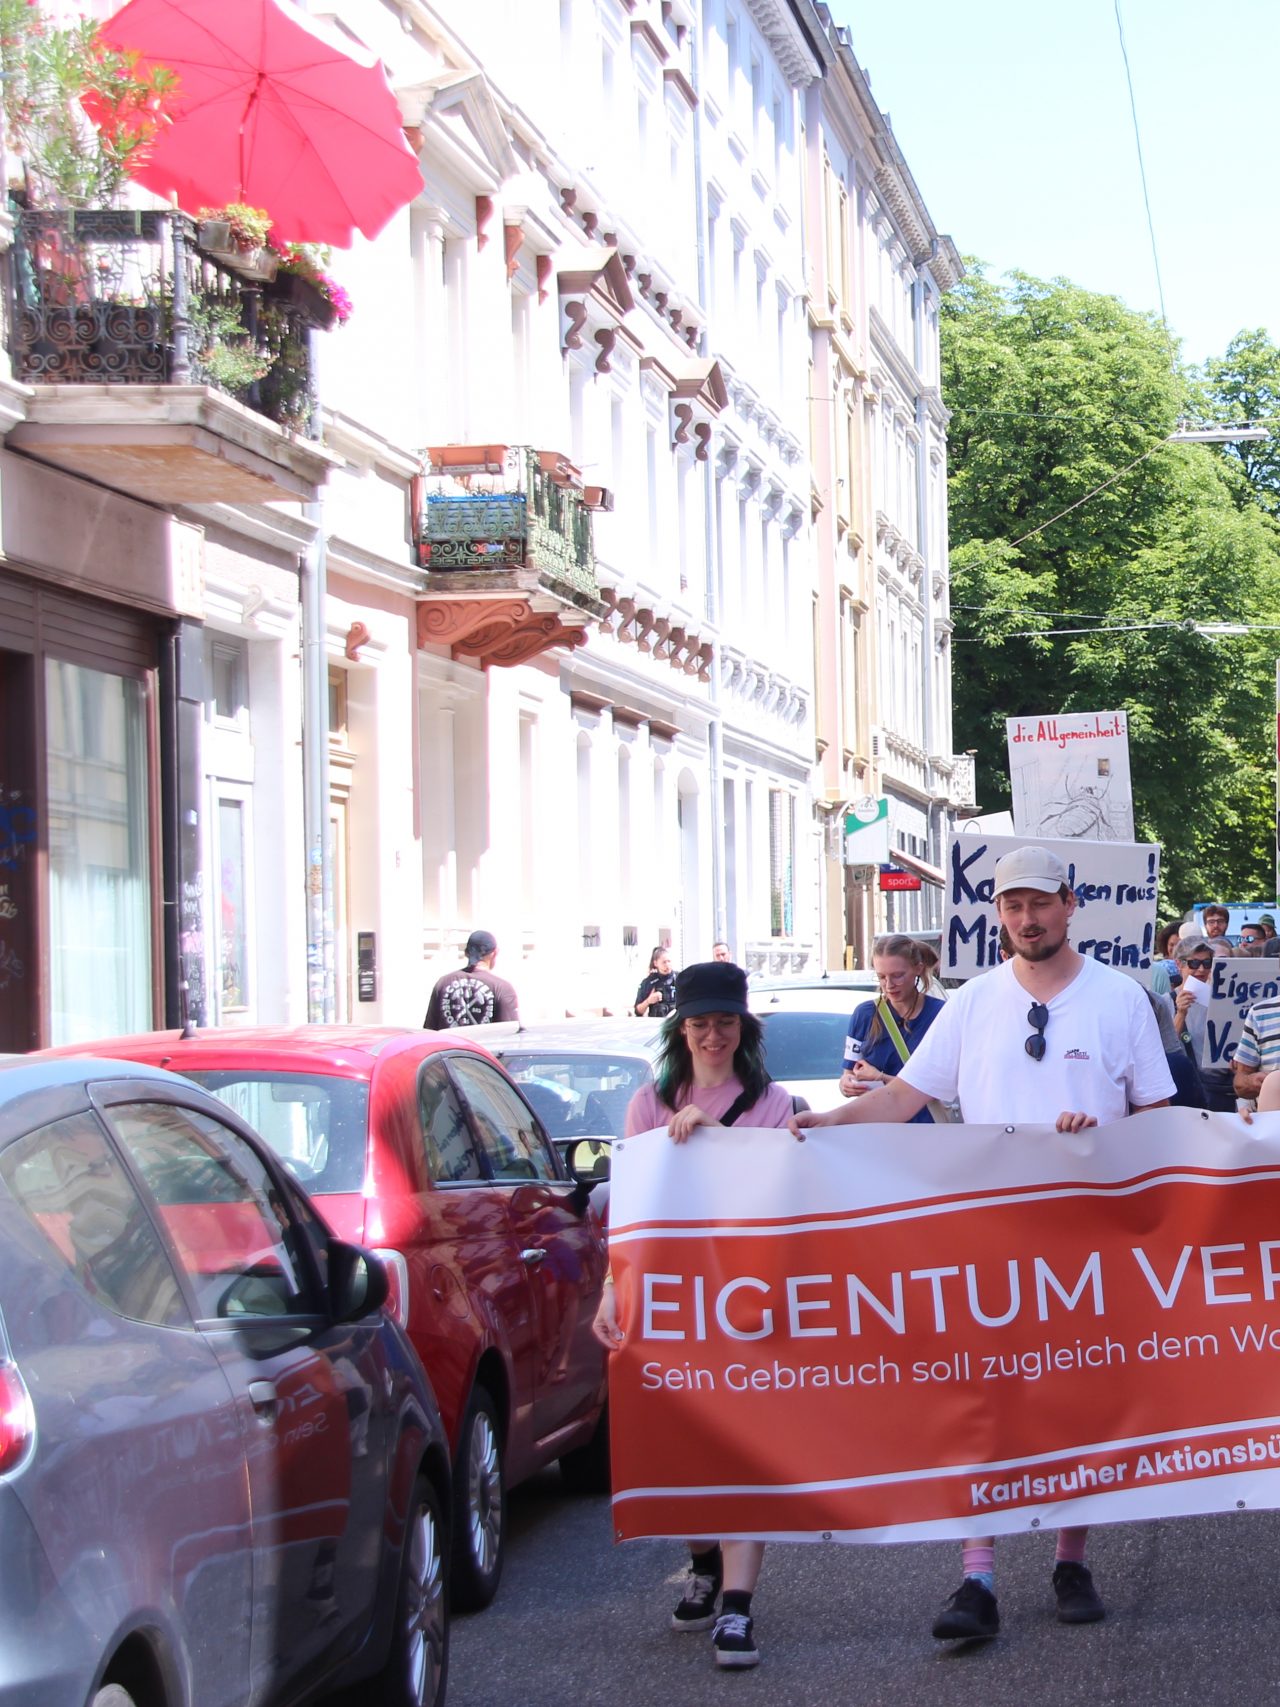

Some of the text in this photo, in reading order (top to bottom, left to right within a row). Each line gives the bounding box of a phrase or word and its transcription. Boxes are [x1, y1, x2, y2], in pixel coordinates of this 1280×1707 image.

[1012, 724, 1034, 743] die
[642, 1251, 1105, 1341] EIGENTUM
[642, 1361, 715, 1391] Sein
[725, 1356, 900, 1391] Gebrauch
[913, 1352, 970, 1382] soll
[983, 1336, 1126, 1381] zugleich
[1137, 1330, 1219, 1361] dem
[970, 1460, 1127, 1507] Karlsruher
